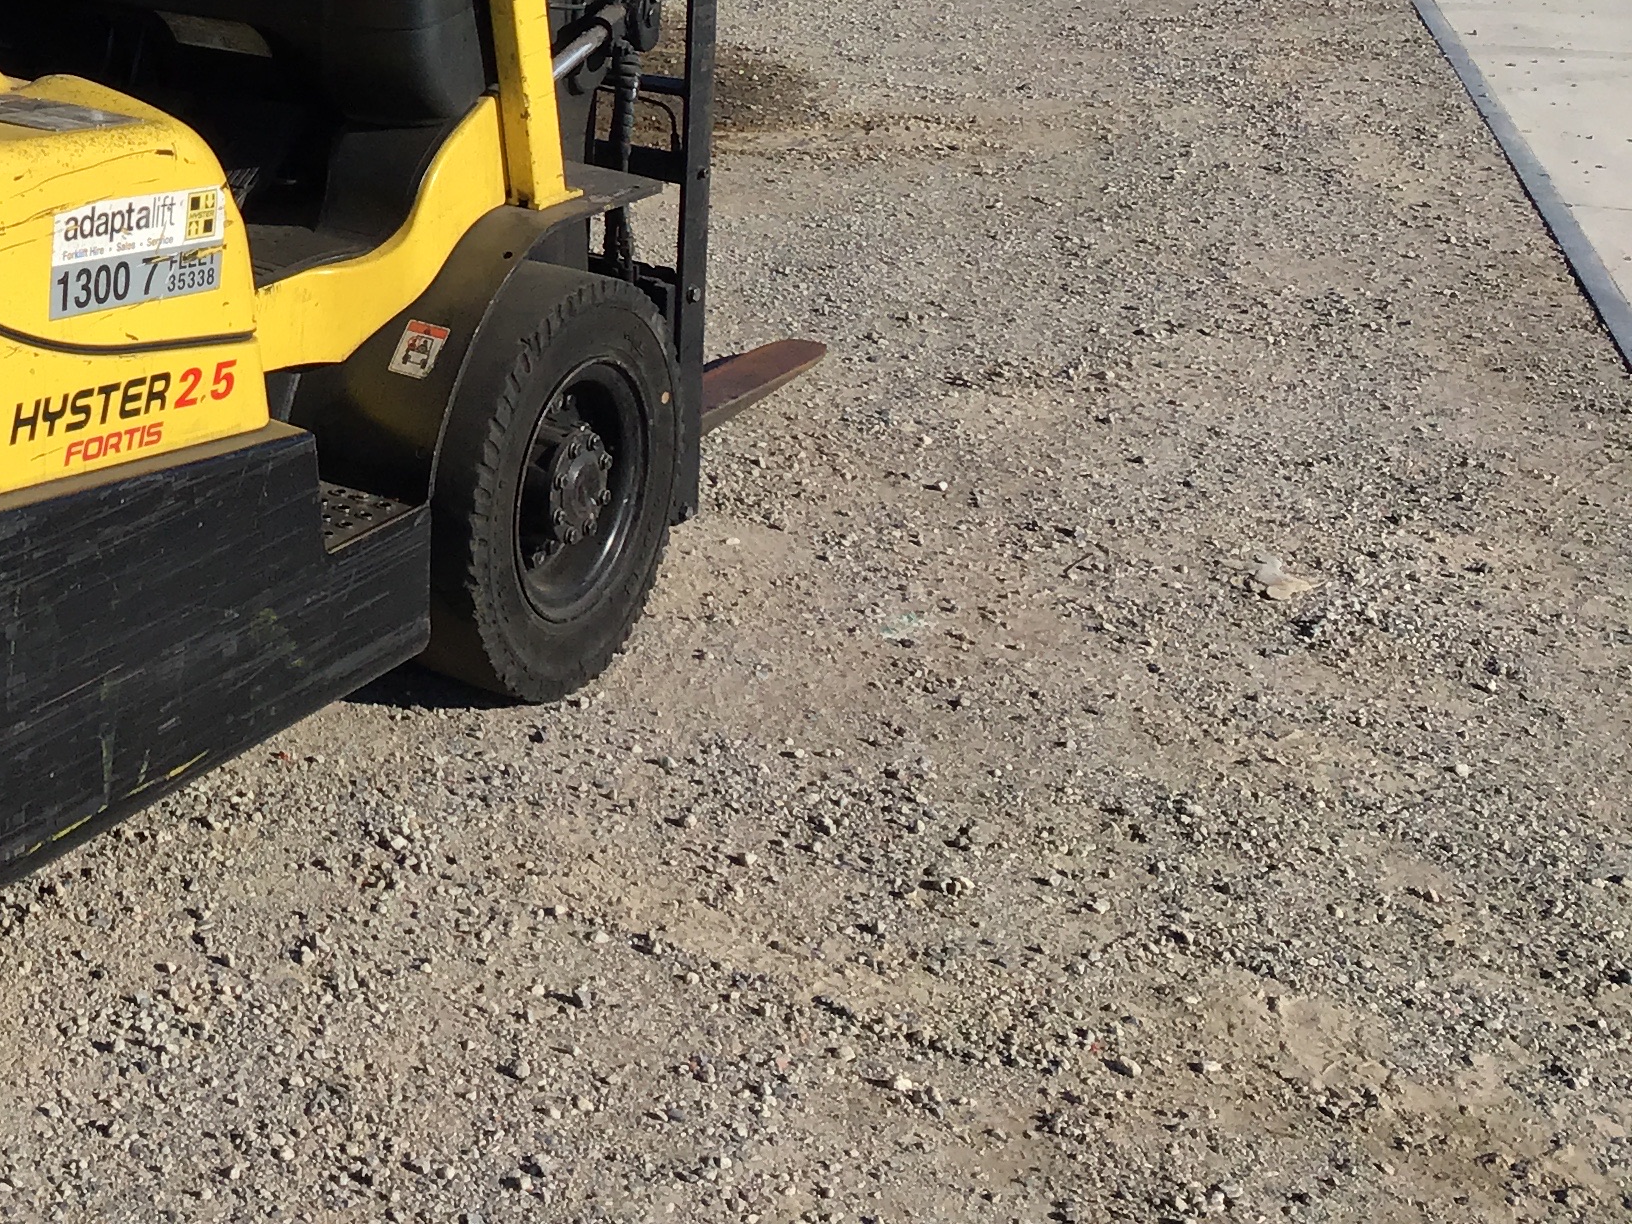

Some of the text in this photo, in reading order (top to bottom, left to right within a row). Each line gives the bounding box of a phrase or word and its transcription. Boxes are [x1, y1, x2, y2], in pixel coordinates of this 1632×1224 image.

[63, 195, 177, 243] adaptalift
[189, 209, 216, 220] HYSTER
[89, 246, 105, 256] Hire
[116, 241, 136, 252] Sales
[146, 235, 174, 248] Service
[56, 260, 131, 312] 1300
[167, 267, 216, 293] 35338
[9, 371, 171, 446] HYSTER
[63, 421, 165, 468] FORTIS
